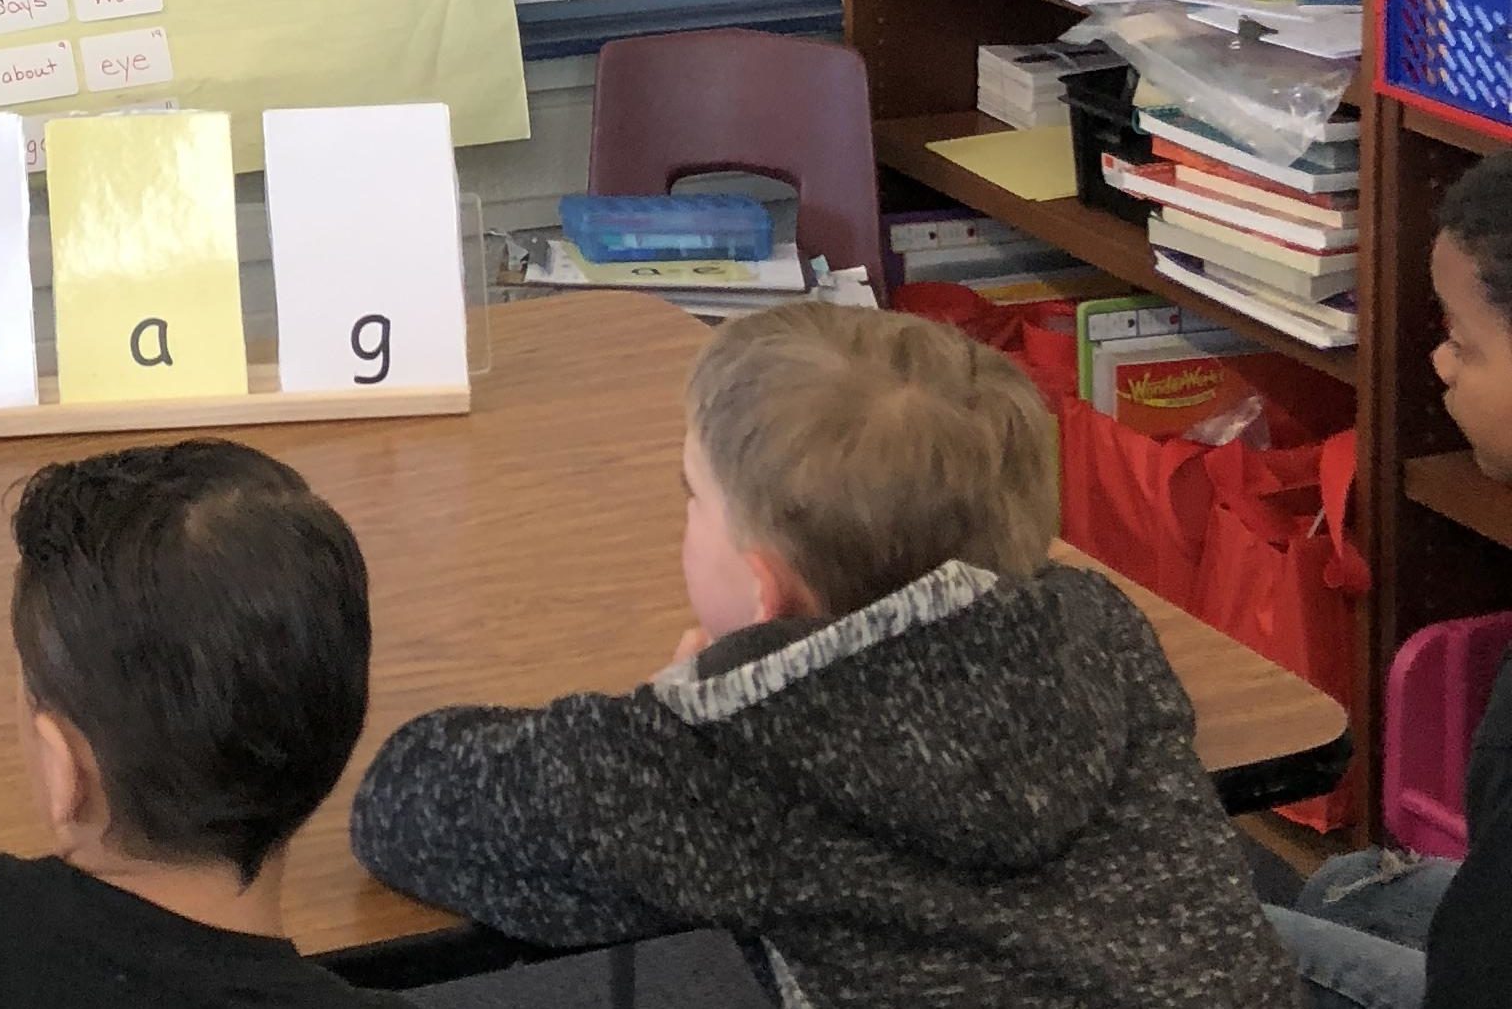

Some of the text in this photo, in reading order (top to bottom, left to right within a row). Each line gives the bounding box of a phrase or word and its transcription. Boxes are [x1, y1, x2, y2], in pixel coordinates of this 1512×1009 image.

[1, 52, 150, 84] about eye
[129, 317, 174, 367] a
[351, 313, 392, 384] g
